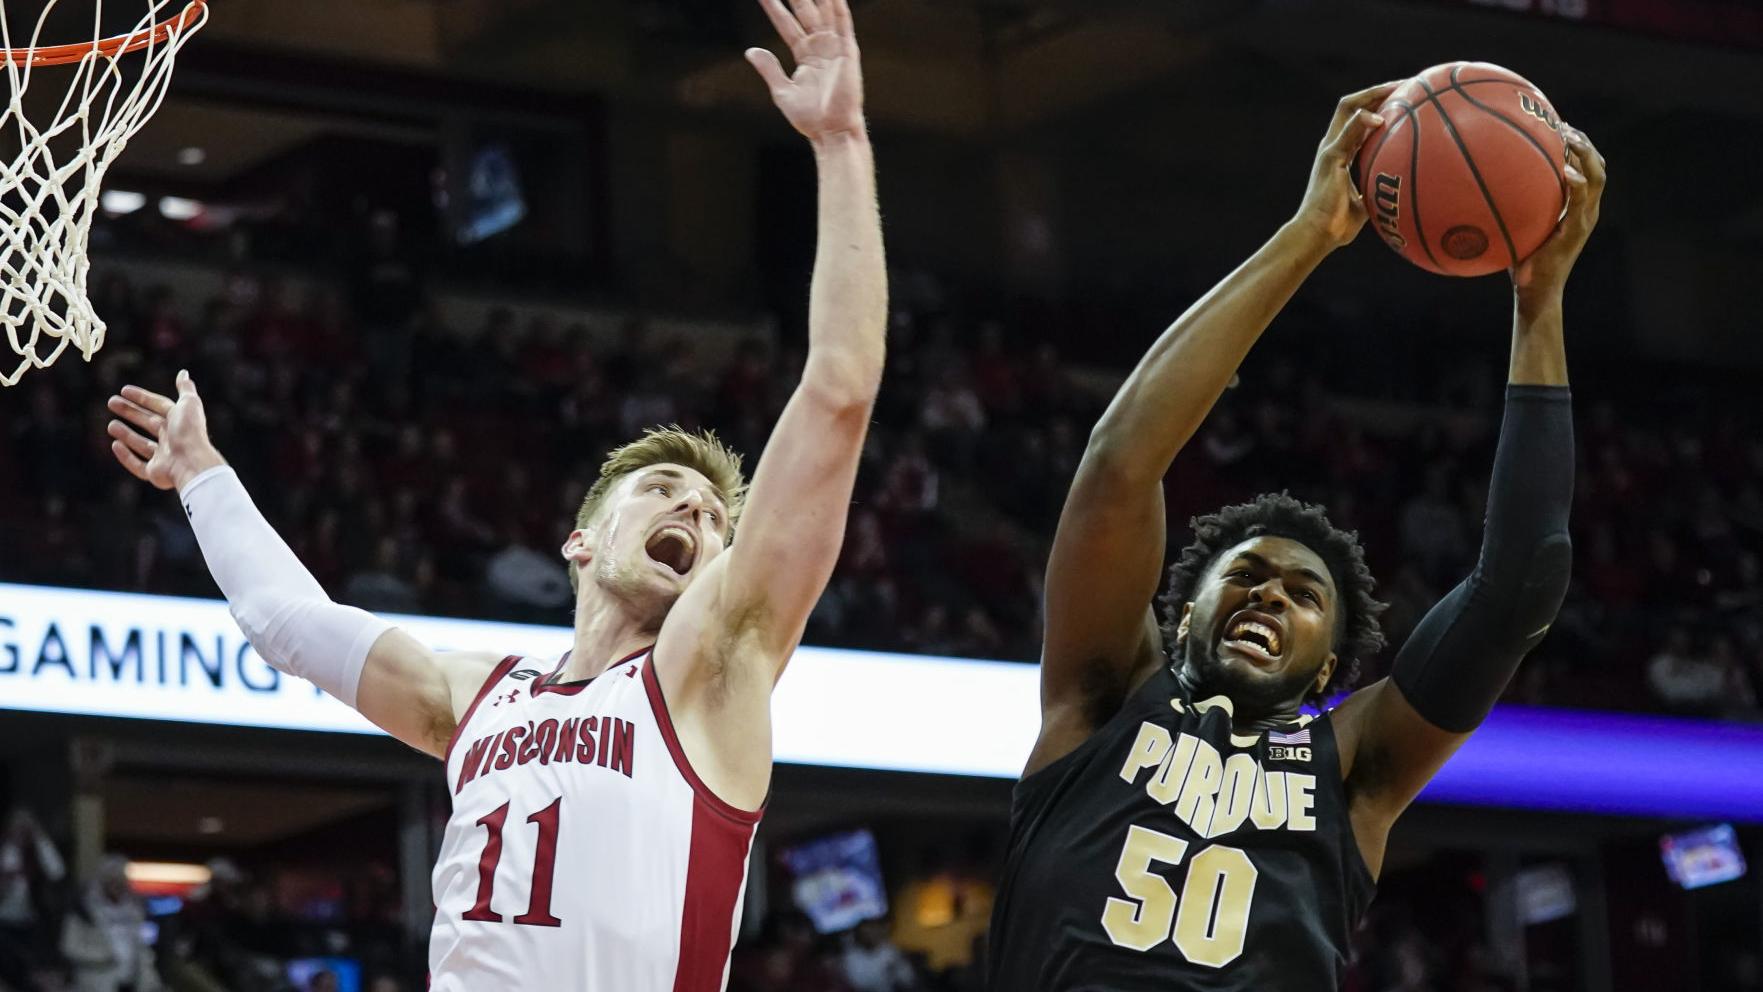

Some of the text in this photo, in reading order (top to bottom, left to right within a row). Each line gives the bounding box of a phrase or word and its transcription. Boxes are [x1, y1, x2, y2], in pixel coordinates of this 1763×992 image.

[455, 715, 635, 796] WISCONSIN
[1119, 721, 1317, 839] PURDUE
[462, 796, 563, 928] 11
[1101, 824, 1259, 969] 50
